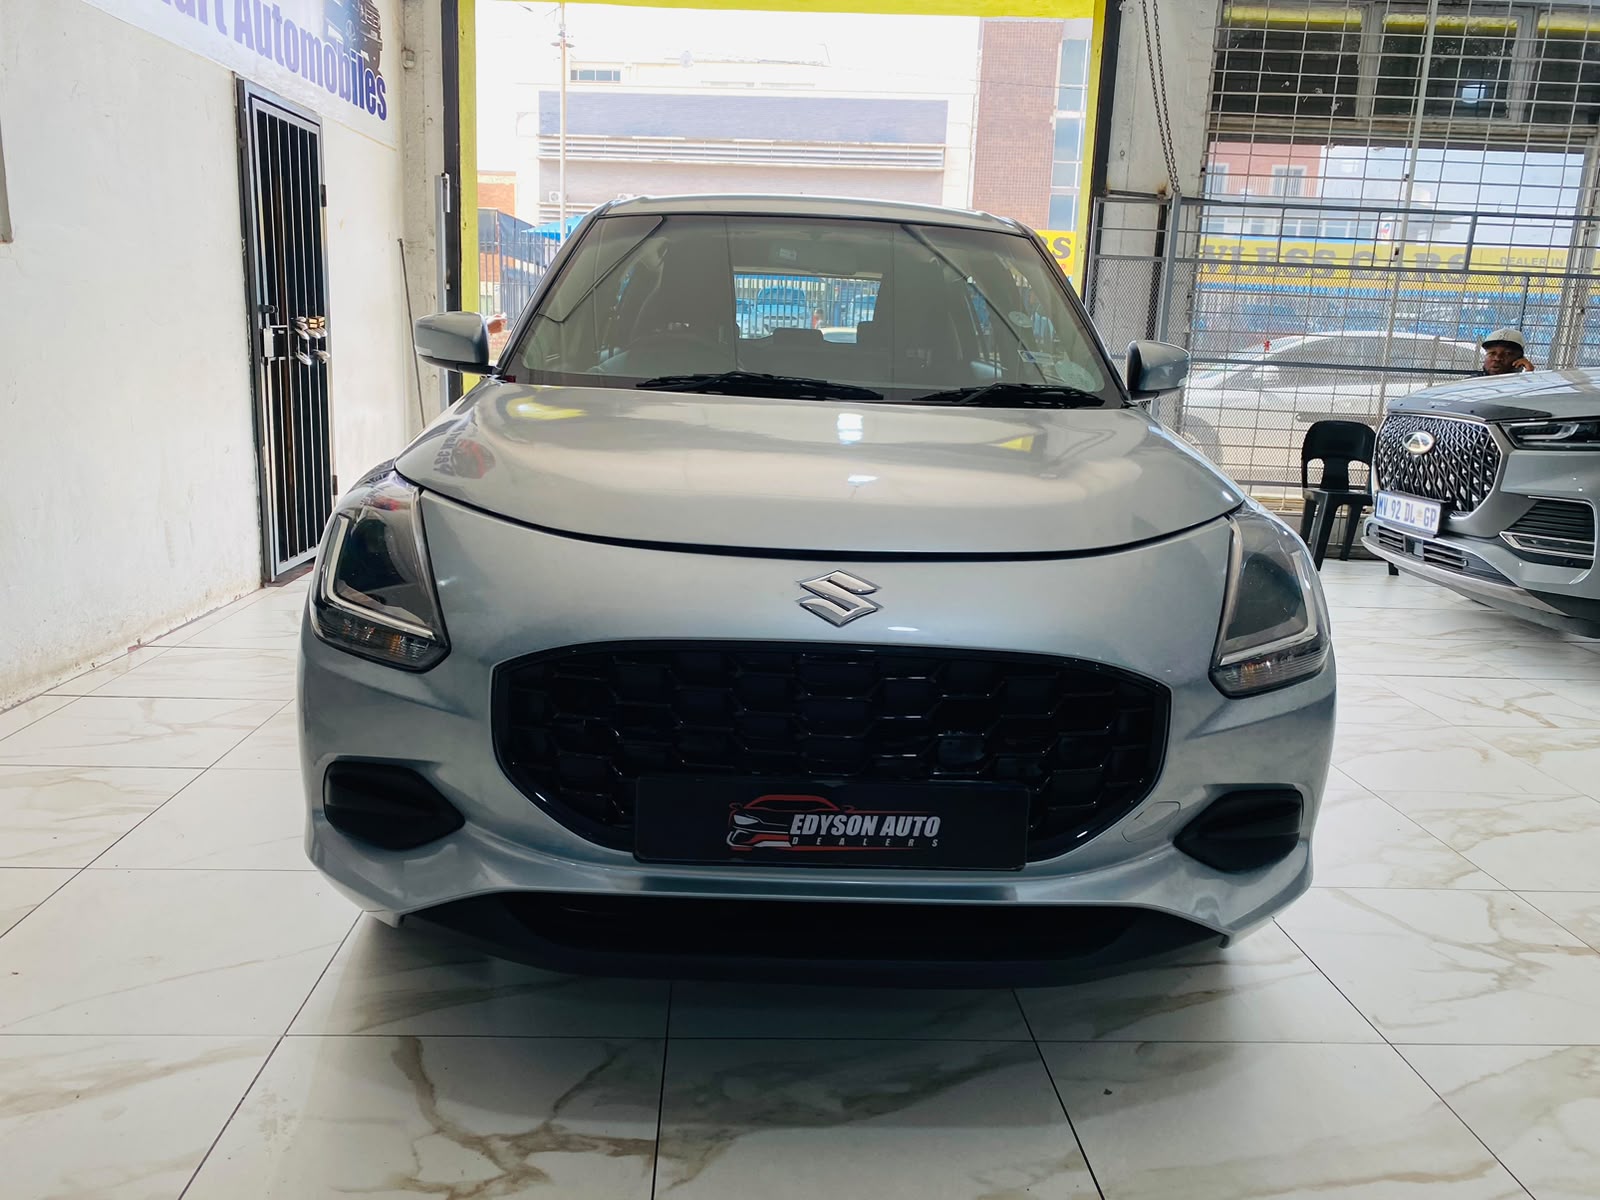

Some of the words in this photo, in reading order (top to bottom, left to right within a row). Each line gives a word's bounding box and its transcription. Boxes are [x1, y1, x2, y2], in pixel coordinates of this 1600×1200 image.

[234, 0, 387, 121] Automobiles
[1500, 256, 1547, 267] DEALER
[1551, 258, 1564, 267] IN
[1391, 500, 1402, 520] 92
[1404, 502, 1416, 524] DL
[1423, 507, 1437, 529] GP
[789, 814, 878, 836] EDYSON
[879, 815, 942, 837] AUTO
[791, 836, 939, 848] DEALERS
